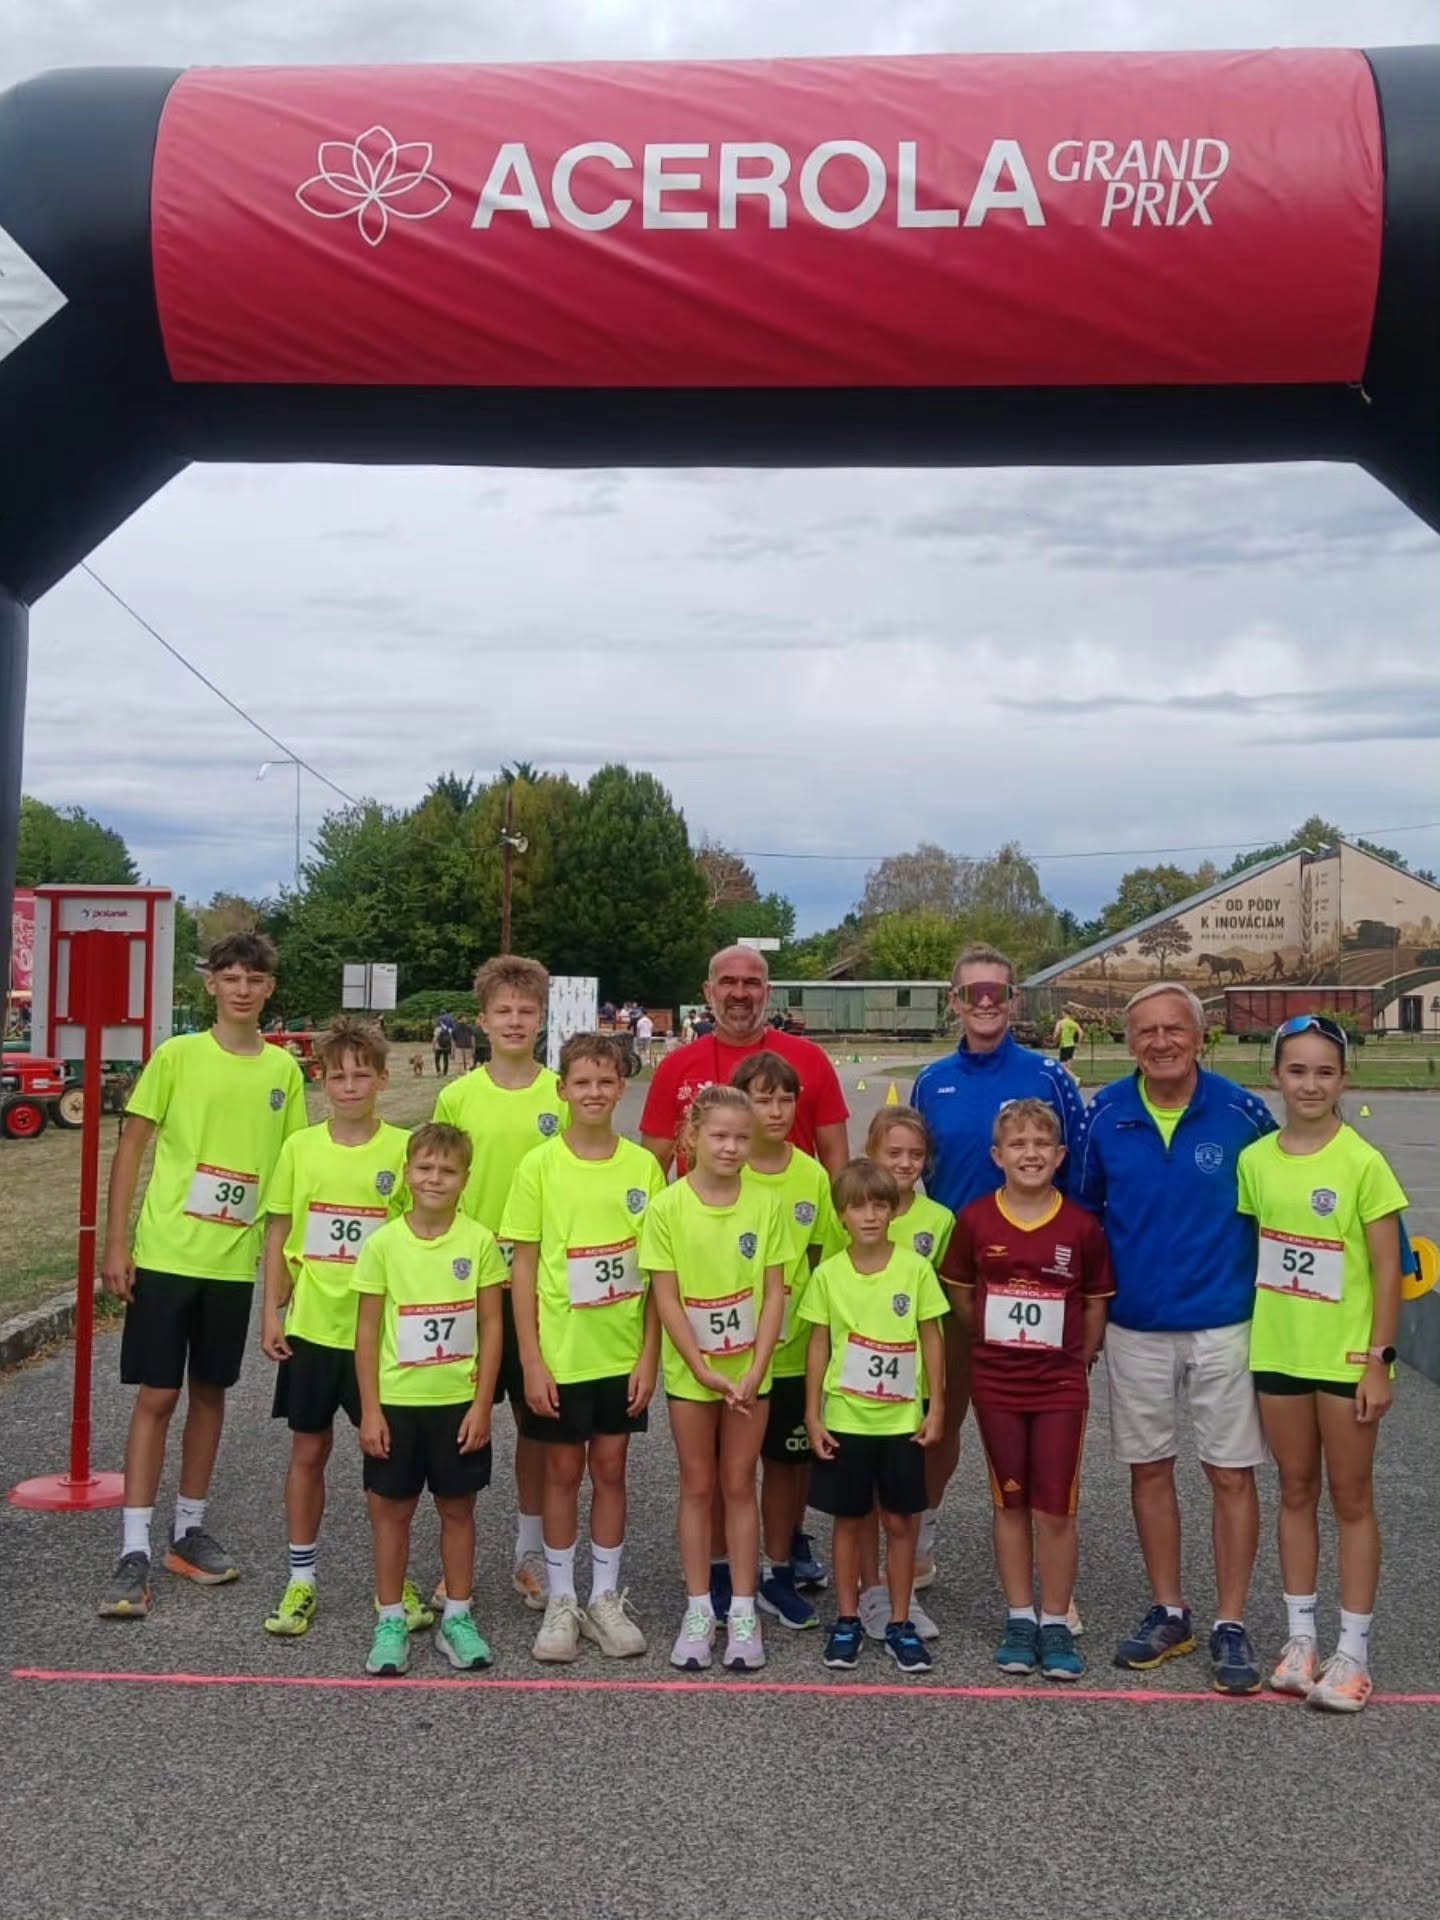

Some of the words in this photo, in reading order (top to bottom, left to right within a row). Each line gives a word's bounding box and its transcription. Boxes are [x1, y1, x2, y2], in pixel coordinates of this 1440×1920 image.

[1047, 137, 1230, 182] GRAND
[471, 139, 1046, 231] ACEROLA
[1100, 180, 1219, 228] PRIX
[1225, 898, 1243, 912] OD
[1247, 895, 1281, 912] PÔDY
[1200, 915, 1209, 929] K
[215, 1181, 245, 1206] 39
[330, 1218, 362, 1242] 36
[594, 1256, 625, 1283] 35
[1282, 1247, 1315, 1276] 52
[709, 1307, 741, 1335] 54
[1007, 1301, 1042, 1327] 40
[423, 1316, 456, 1343] 37
[867, 1354, 899, 1380] 34
